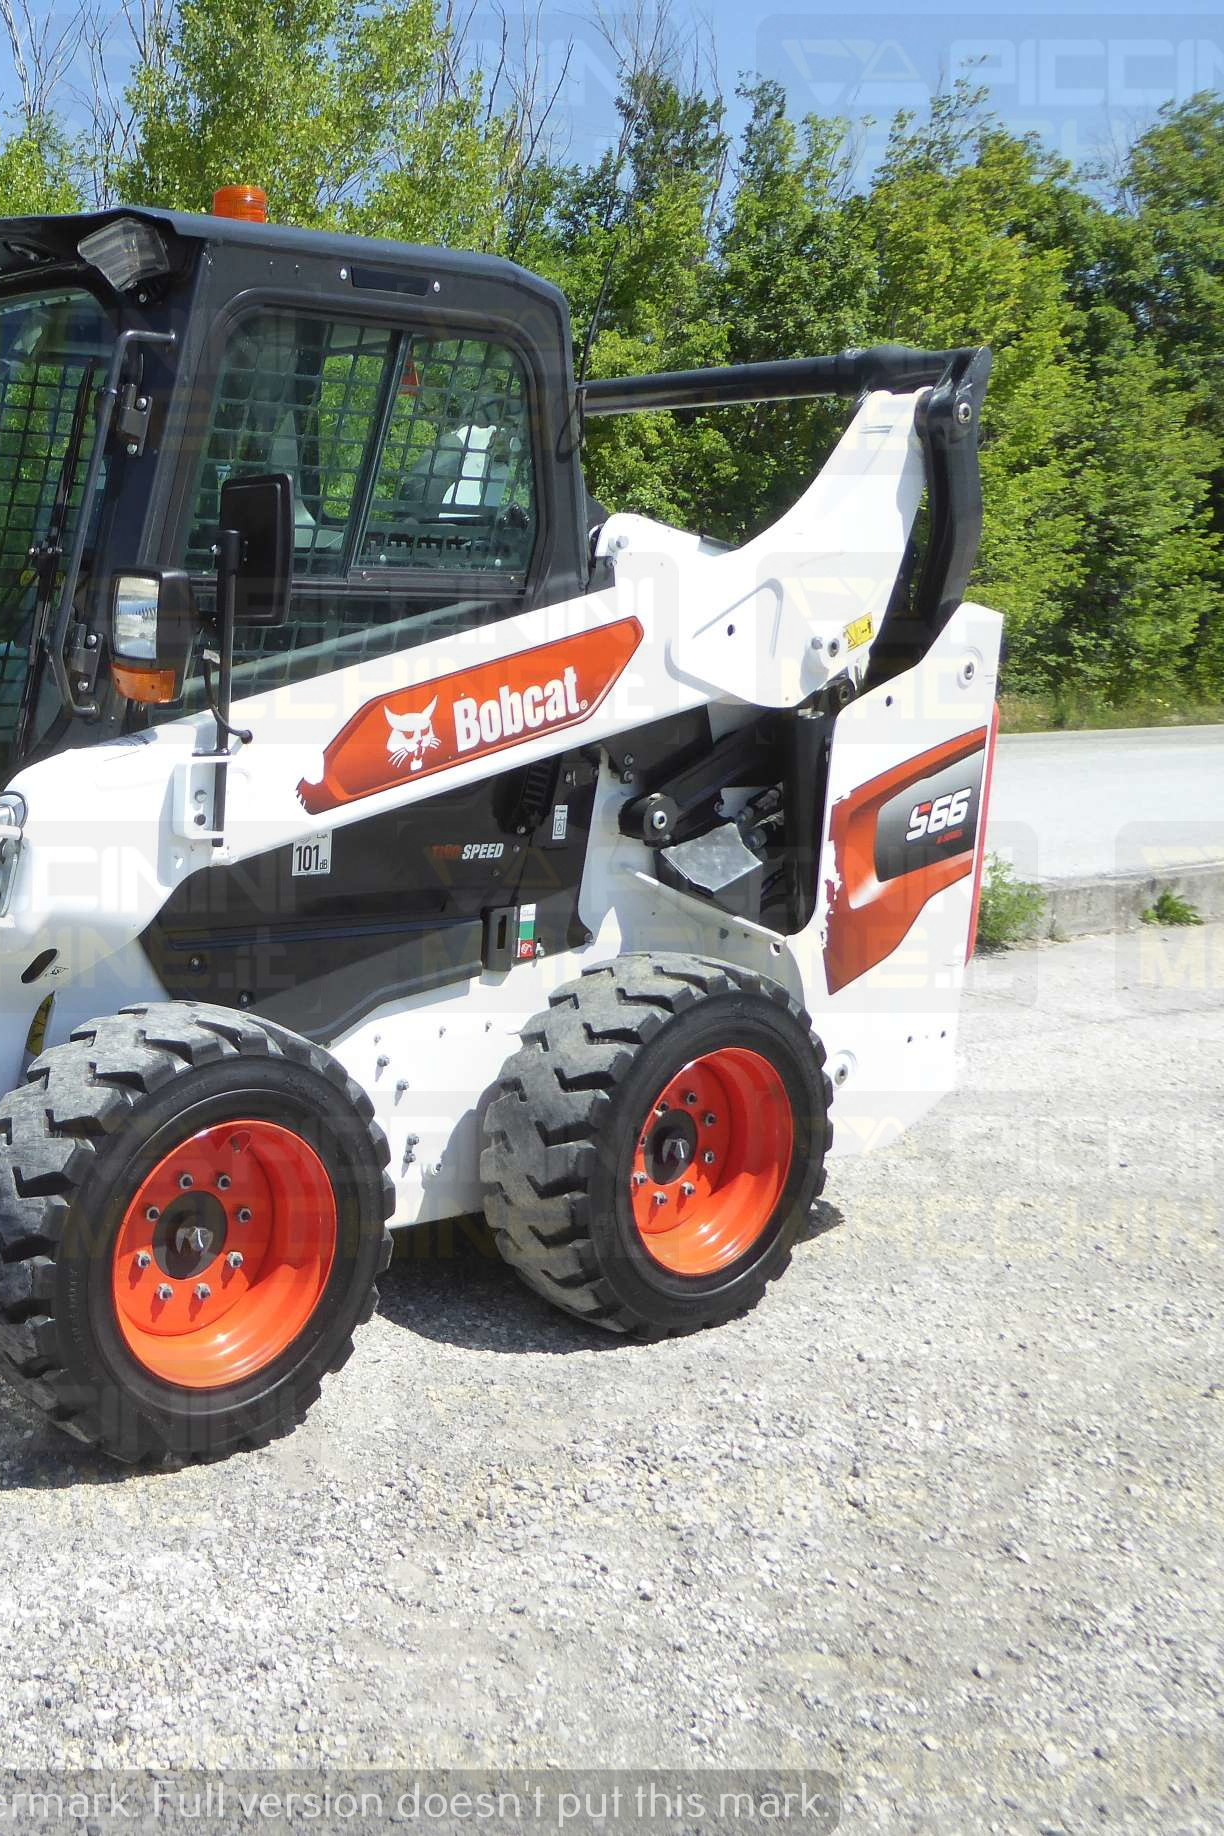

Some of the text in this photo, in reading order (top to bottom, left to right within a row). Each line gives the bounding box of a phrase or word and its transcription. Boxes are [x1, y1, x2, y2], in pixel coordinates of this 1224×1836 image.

[905, 787, 972, 841] S66
[296, 844, 320, 872] 101
[461, 842, 505, 860] SPEED
